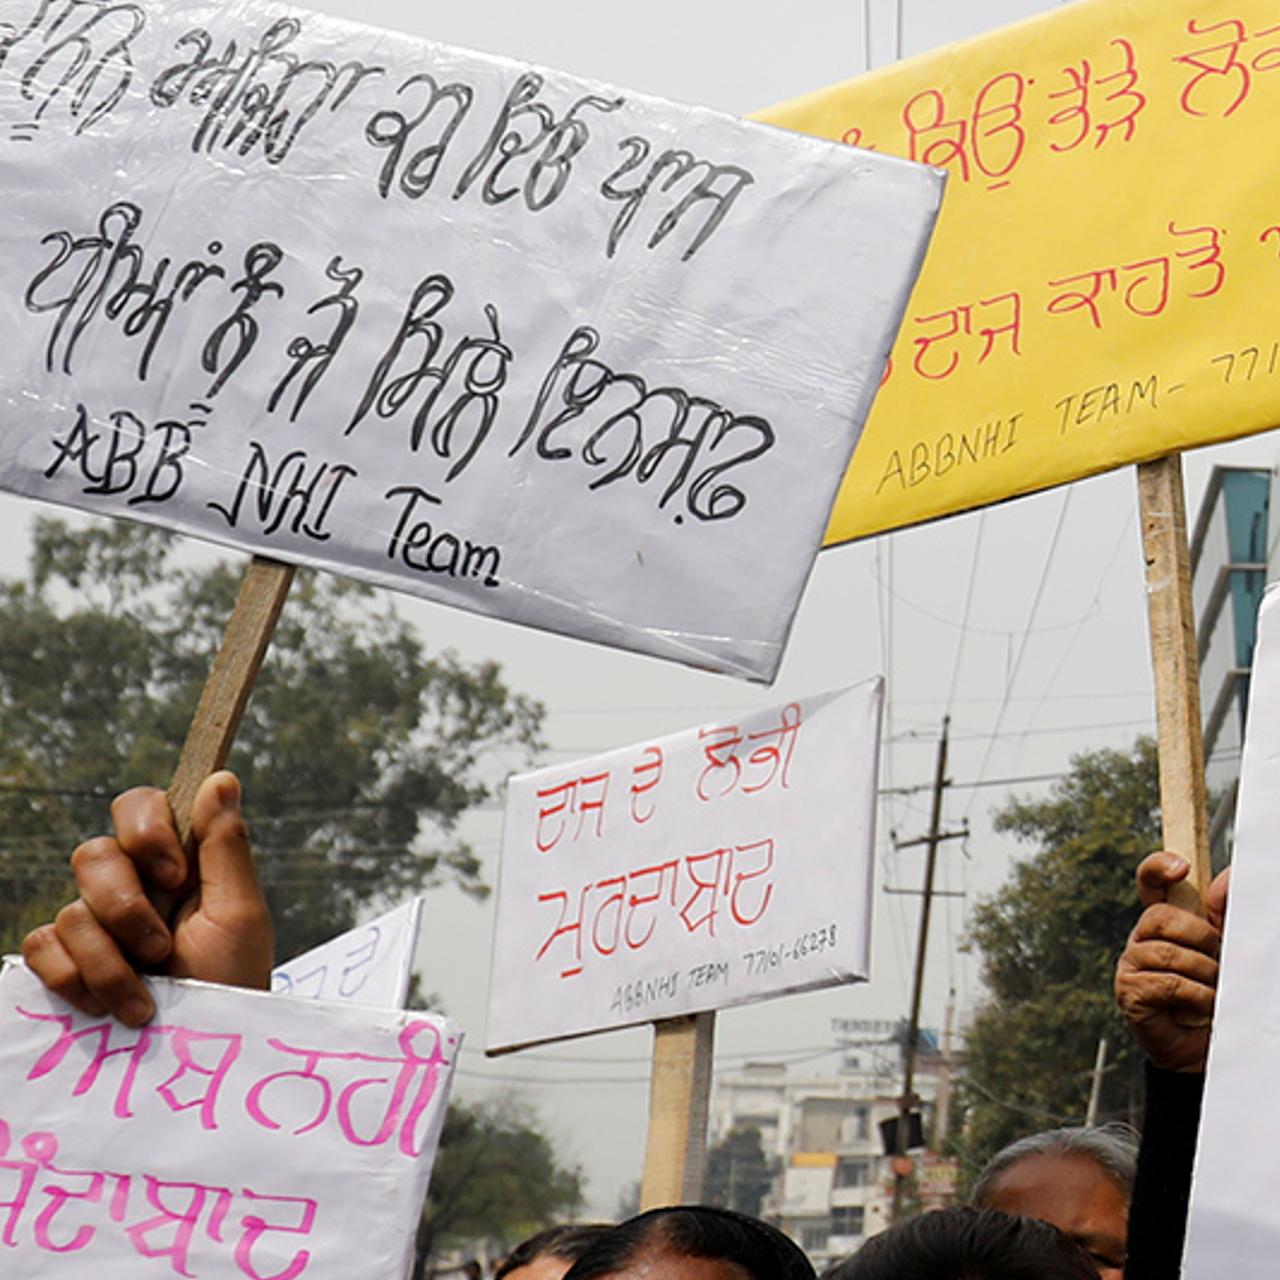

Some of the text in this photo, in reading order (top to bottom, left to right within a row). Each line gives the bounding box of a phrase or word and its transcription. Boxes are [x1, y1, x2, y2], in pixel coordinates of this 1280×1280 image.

[45, 404, 191, 504] ABB
[385, 486, 499, 586] Team
[875, 413, 1023, 494] ABBNHI
[536, 772, 610, 852] ਦਾਜ
[630, 746, 663, 824] ਦੇ
[687, 961, 730, 989] TEAM
